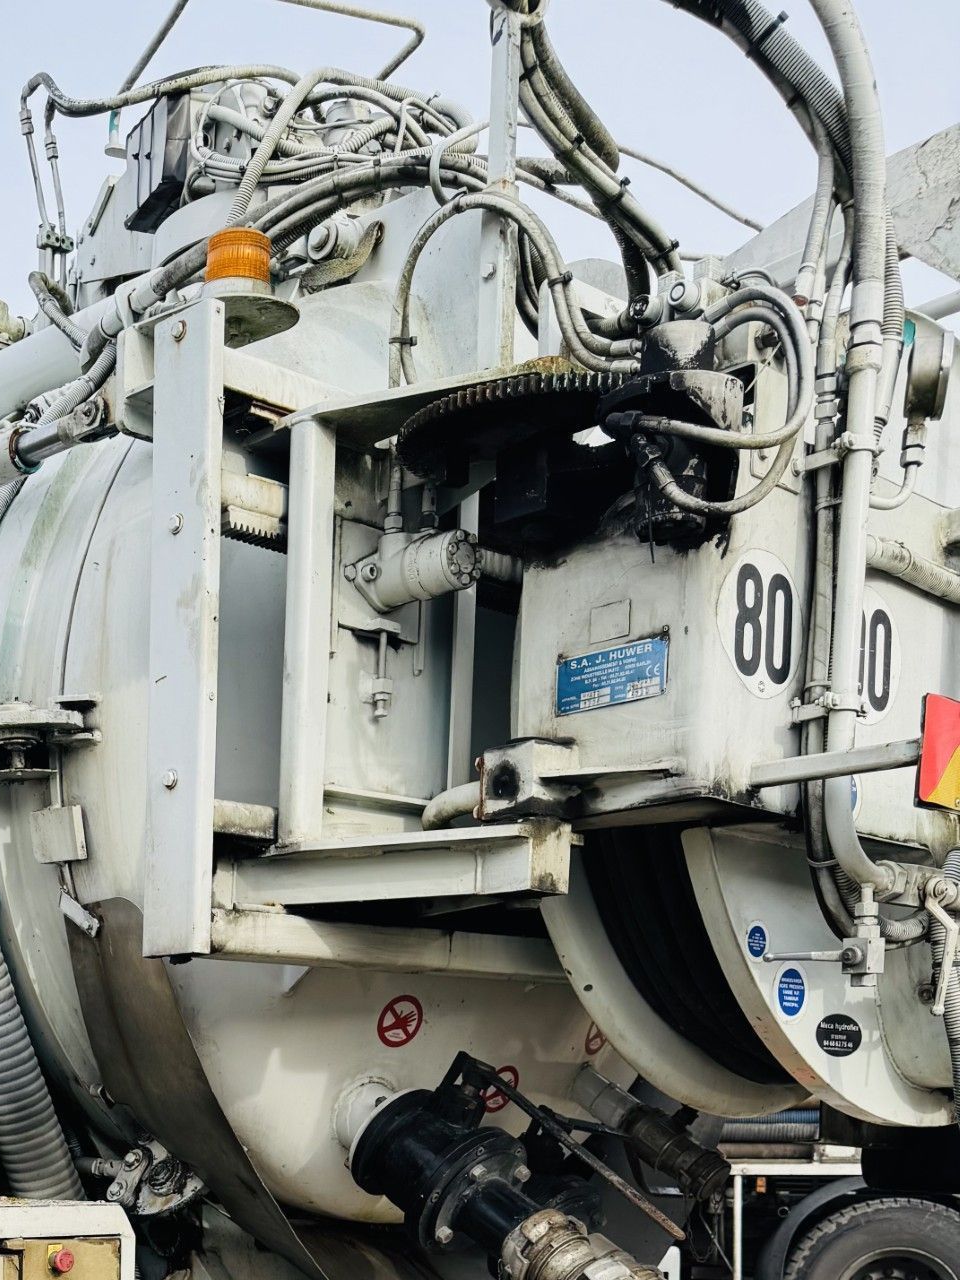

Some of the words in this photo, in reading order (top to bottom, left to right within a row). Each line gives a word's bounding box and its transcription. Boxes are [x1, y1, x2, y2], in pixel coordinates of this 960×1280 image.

[570, 658, 591, 670] S.A.
[596, 654, 605, 664] J.
[609, 643, 652, 660] HUWER
[734, 562, 792, 685] 80
[857, 608, 892, 712] 0
